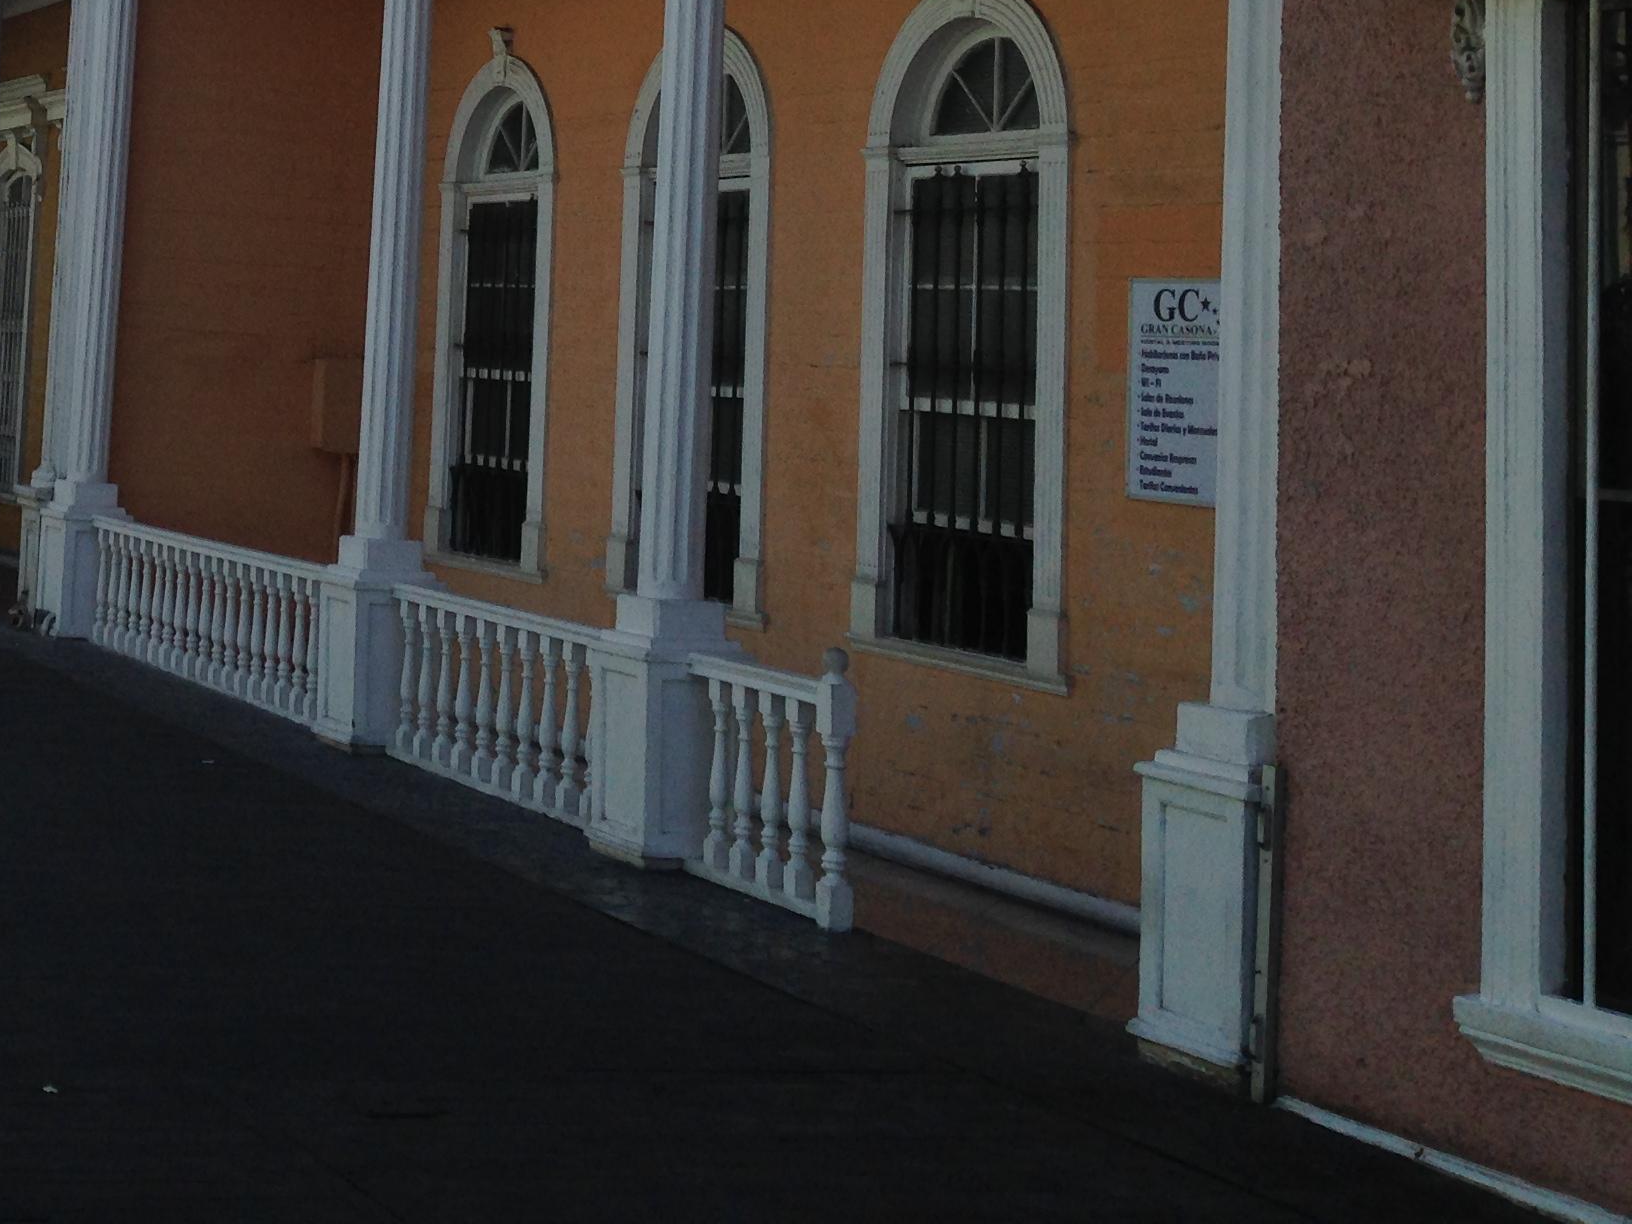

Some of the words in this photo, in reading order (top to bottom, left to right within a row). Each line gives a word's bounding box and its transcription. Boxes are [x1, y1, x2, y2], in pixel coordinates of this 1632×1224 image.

[1153, 288, 1200, 322] GC
[1140, 324, 1168, 335] GRAN
[1171, 324, 1213, 336] CASONA
